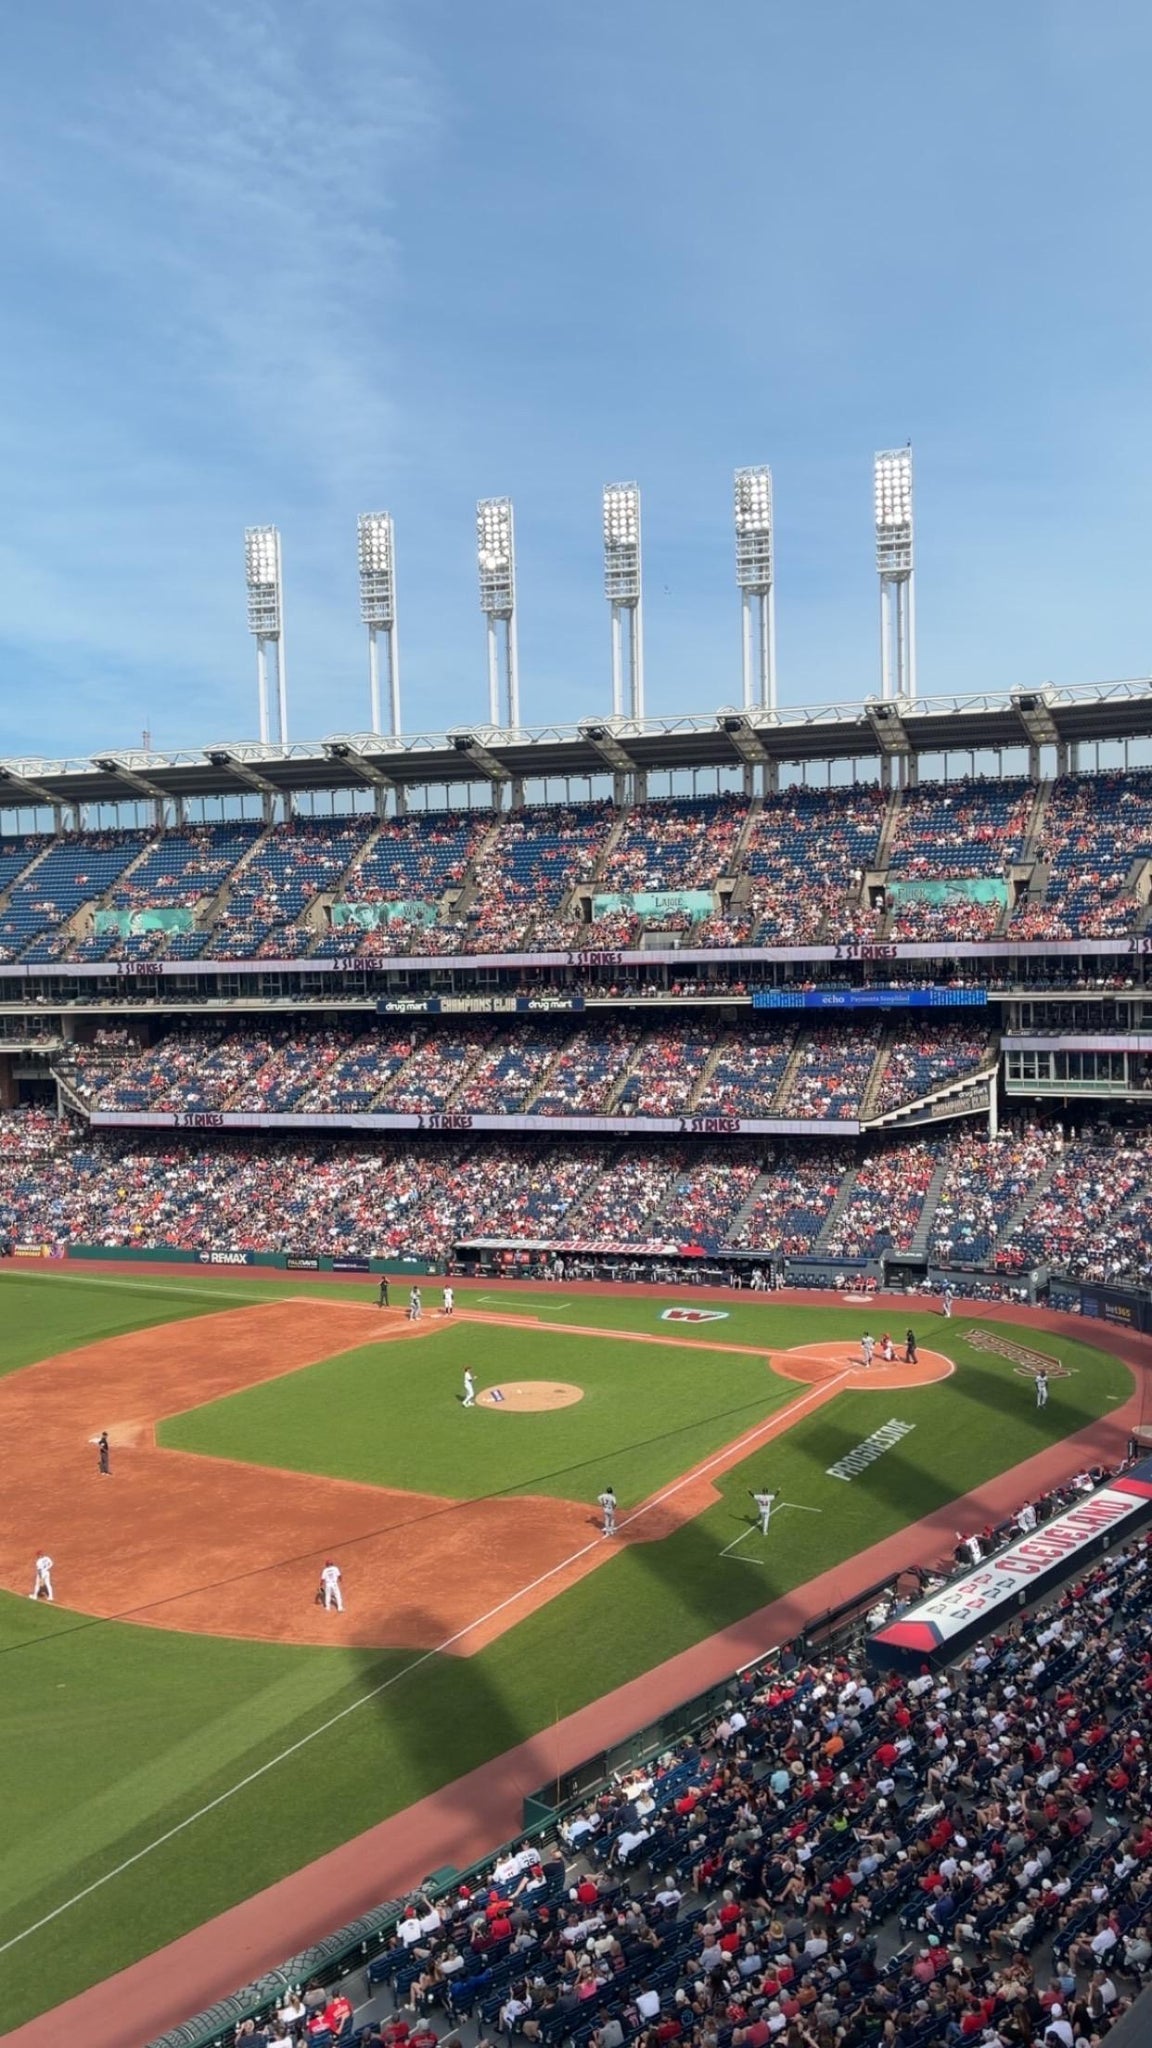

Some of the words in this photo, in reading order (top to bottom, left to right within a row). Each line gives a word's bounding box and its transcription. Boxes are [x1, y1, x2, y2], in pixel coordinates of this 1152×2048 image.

[567, 952, 575, 965] 2
[577, 951, 622, 965] STRIKES
[835, 945, 843, 958] 2
[847, 944, 897, 960] STRIKES
[117, 962, 124, 974] 2
[126, 961, 163, 974] STRIKES
[333, 957, 340, 969] 2
[342, 957, 383, 970] STRIKES
[385, 1002, 405, 1013] drug
[407, 1002, 427, 1011] mart
[528, 1000, 549, 1011] drug
[550, 1000, 573, 1008] mart
[173, 1113, 179, 1126] 2
[184, 1113, 223, 1127] STRIKES
[417, 1115, 425, 1129] 2
[430, 1115, 473, 1129] STRIKES
[679, 1117, 687, 1132] 2
[691, 1117, 740, 1132] STRIKES
[546, 1240, 665, 1254] GUARDIANS
[825, 1418, 917, 1481] PROGRESSIVE
[994, 1499, 1134, 1575] CLEVELAND
